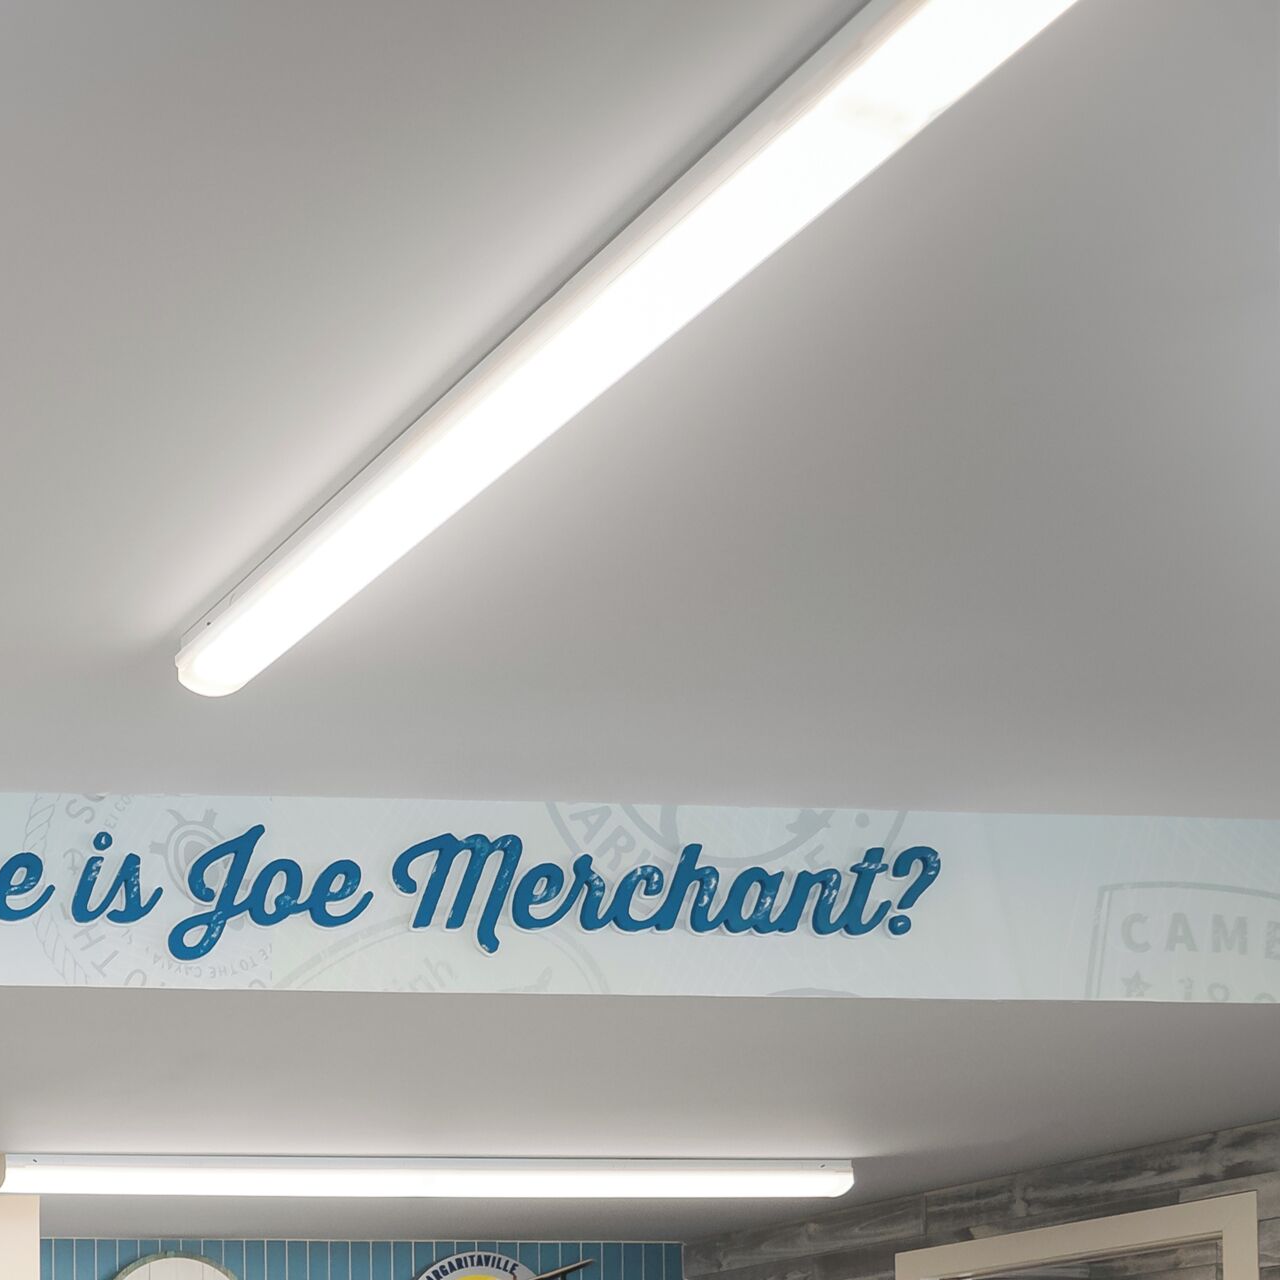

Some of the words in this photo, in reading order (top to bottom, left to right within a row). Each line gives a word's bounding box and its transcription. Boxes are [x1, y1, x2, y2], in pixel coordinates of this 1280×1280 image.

[71, 831, 163, 923] is
[167, 823, 375, 962] Joe
[392, 831, 942, 957] Merchant?
